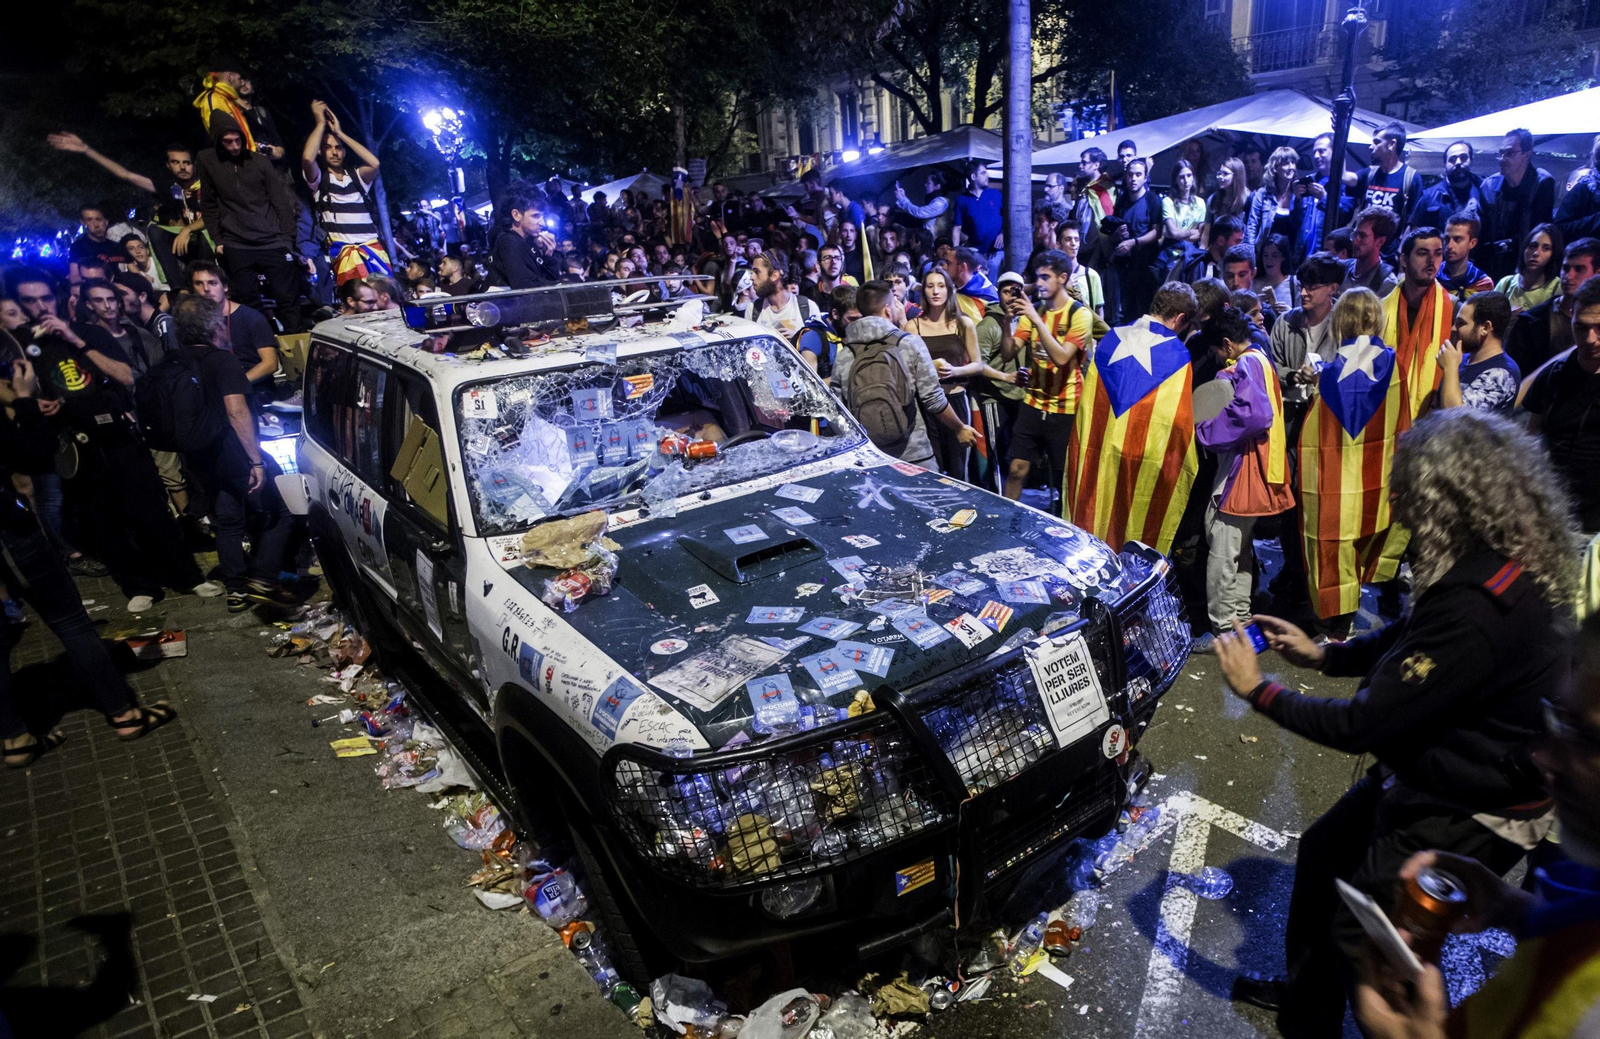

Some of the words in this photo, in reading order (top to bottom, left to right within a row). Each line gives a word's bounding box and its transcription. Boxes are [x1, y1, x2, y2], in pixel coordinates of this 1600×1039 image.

[1366, 190, 1397, 206] FCK
[1044, 651, 1080, 676] VOTEM
[1045, 673, 1066, 692] PER
[1067, 663, 1087, 680] SER
[1050, 675, 1091, 705] LLIURES
[638, 719, 675, 734] ESCAC
